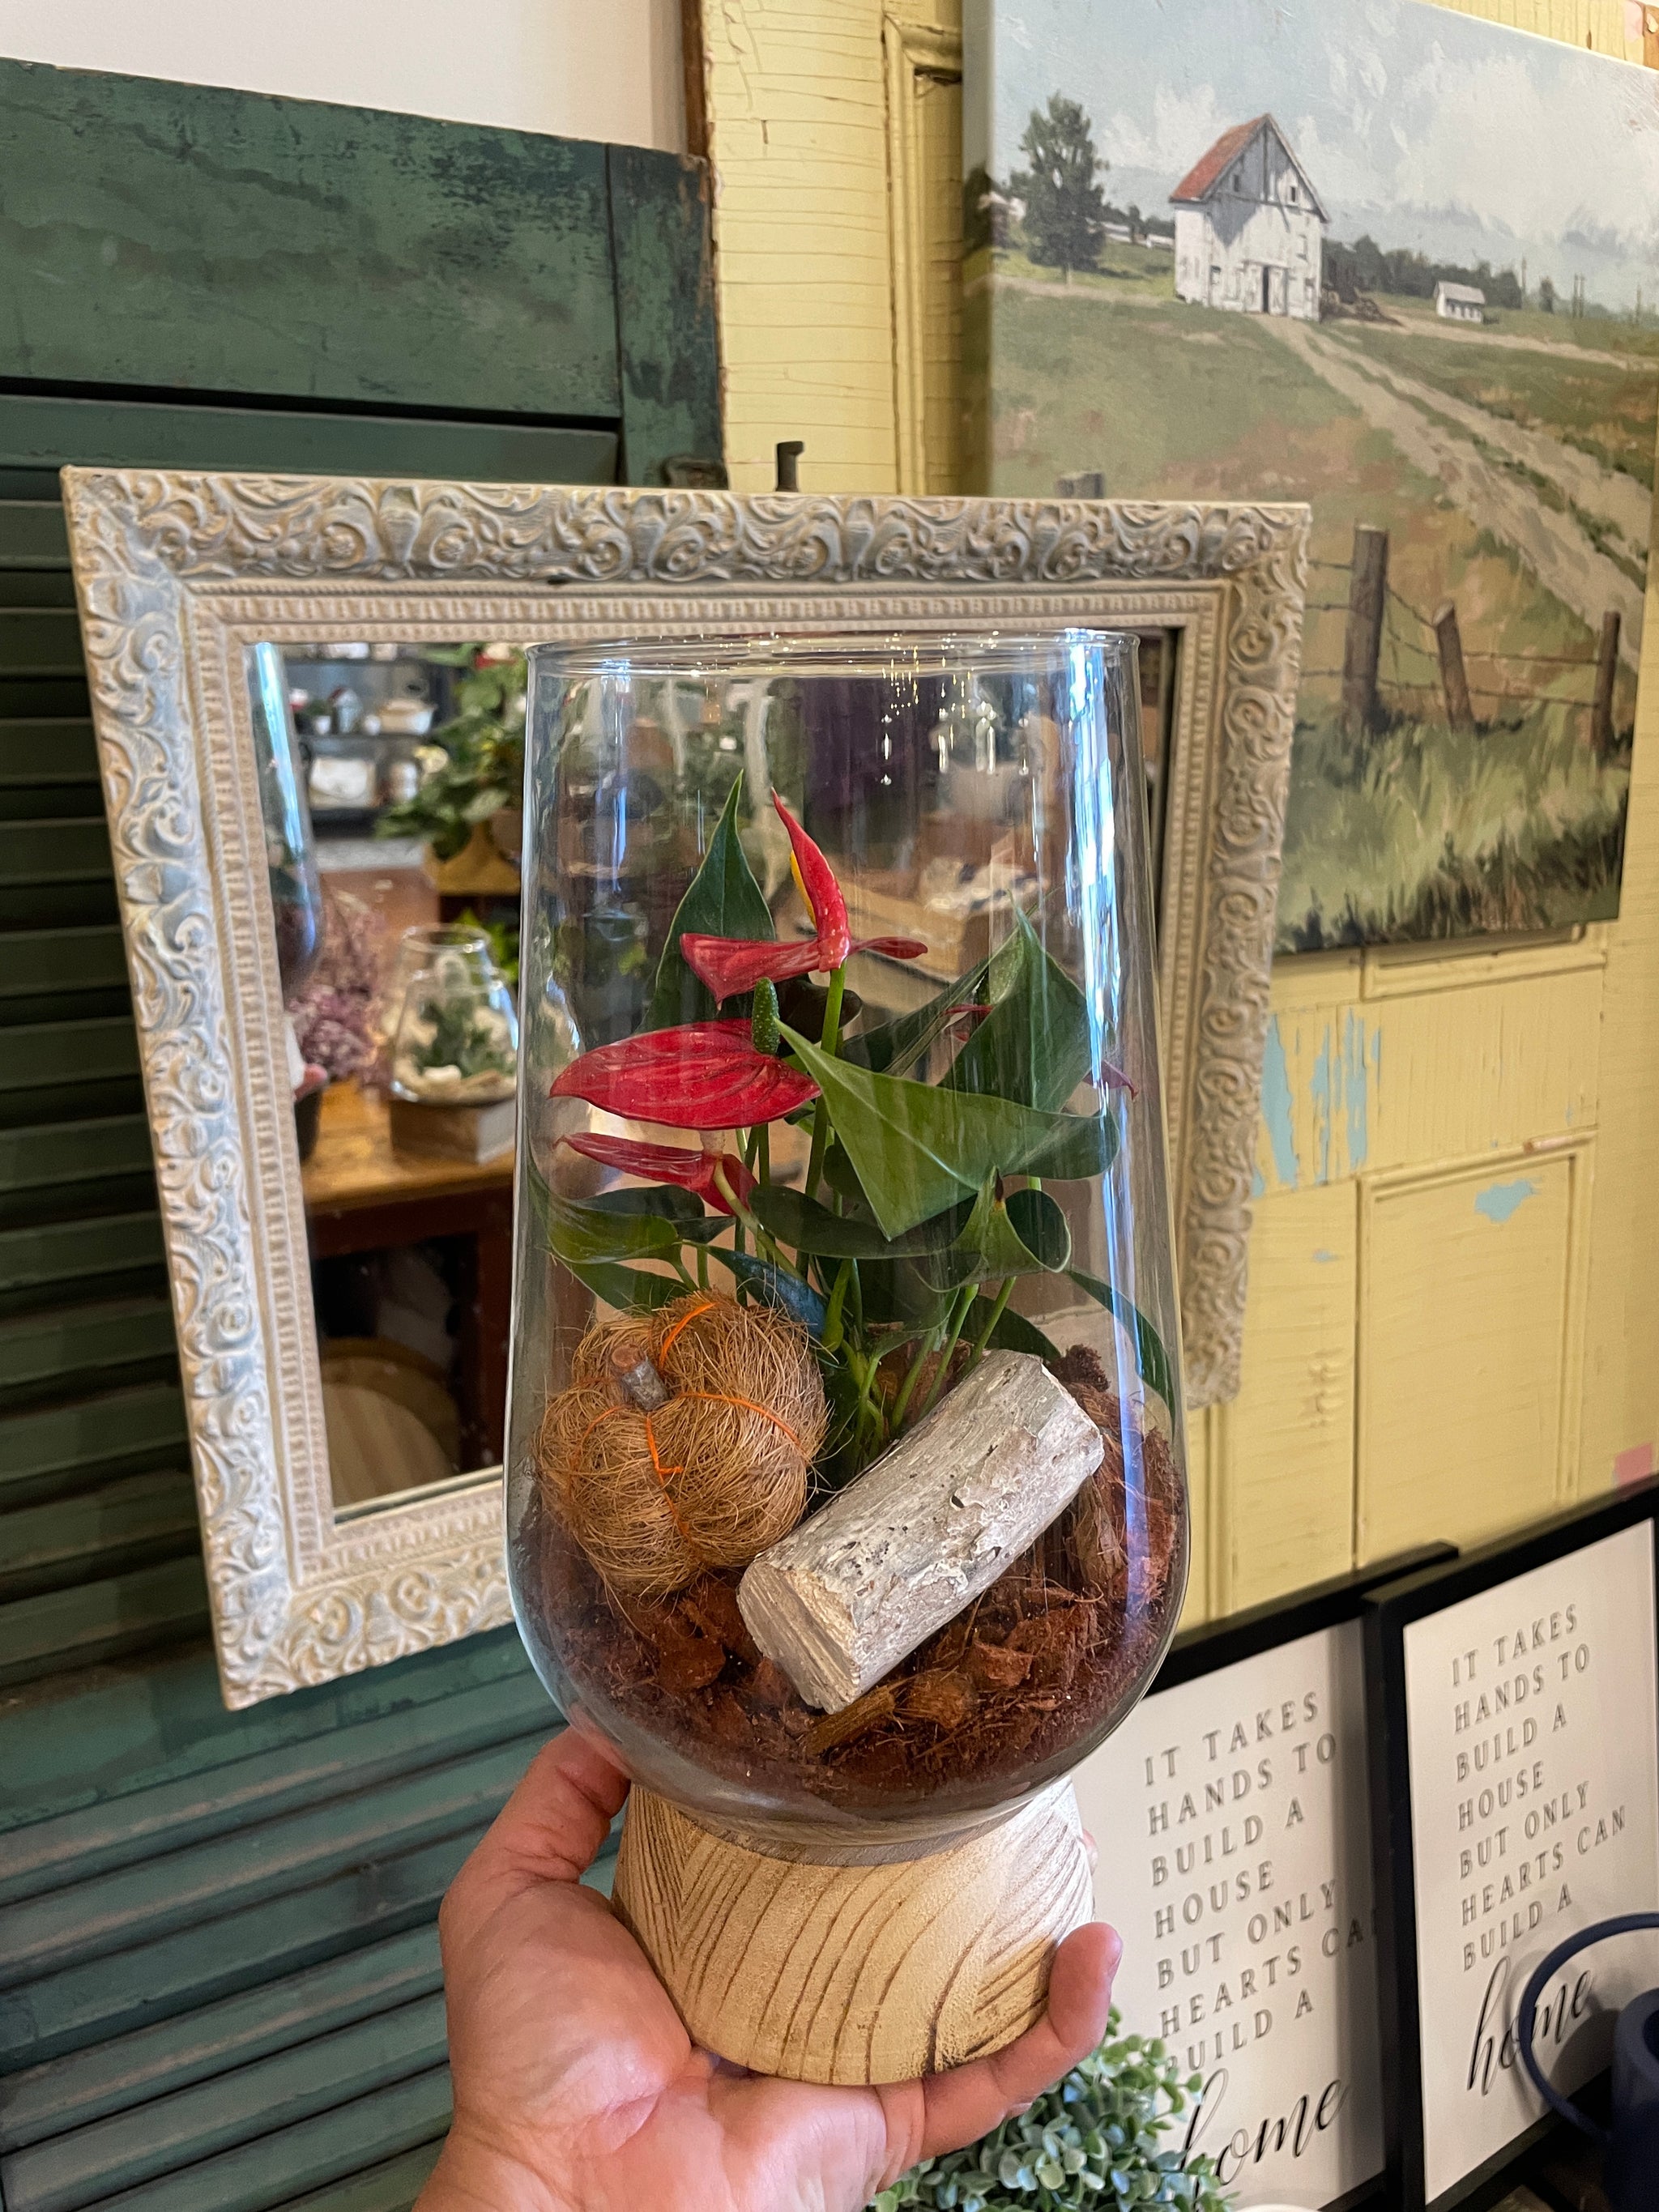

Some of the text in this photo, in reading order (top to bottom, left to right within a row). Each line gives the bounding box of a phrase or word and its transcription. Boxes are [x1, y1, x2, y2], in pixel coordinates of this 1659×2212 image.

[1452, 1604, 1579, 1686] IT TAKES
[1454, 1644, 1589, 1733] HANDS TO
[1145, 1691, 1319, 1785] IT TAKES
[1456, 1703, 1567, 1781] BUILD A
[1149, 1733, 1337, 1835] HANDS TO
[1459, 1761, 1543, 1830] HOUSE
[1152, 1796, 1304, 1886] BUILD A
[1460, 1781, 1589, 1878] BUT ONLY
[1462, 1807, 1627, 1925] HEARTS CAN
[1155, 1861, 1274, 1937] HOUSE
[1158, 1880, 1337, 1988] BUT ONLY
[1465, 1883, 1572, 1971] BUILD A
[1160, 1910, 1377, 2038] HEARTS CA
[1295, 1990, 1314, 2018] A
[1467, 1956, 1593, 2095] home
